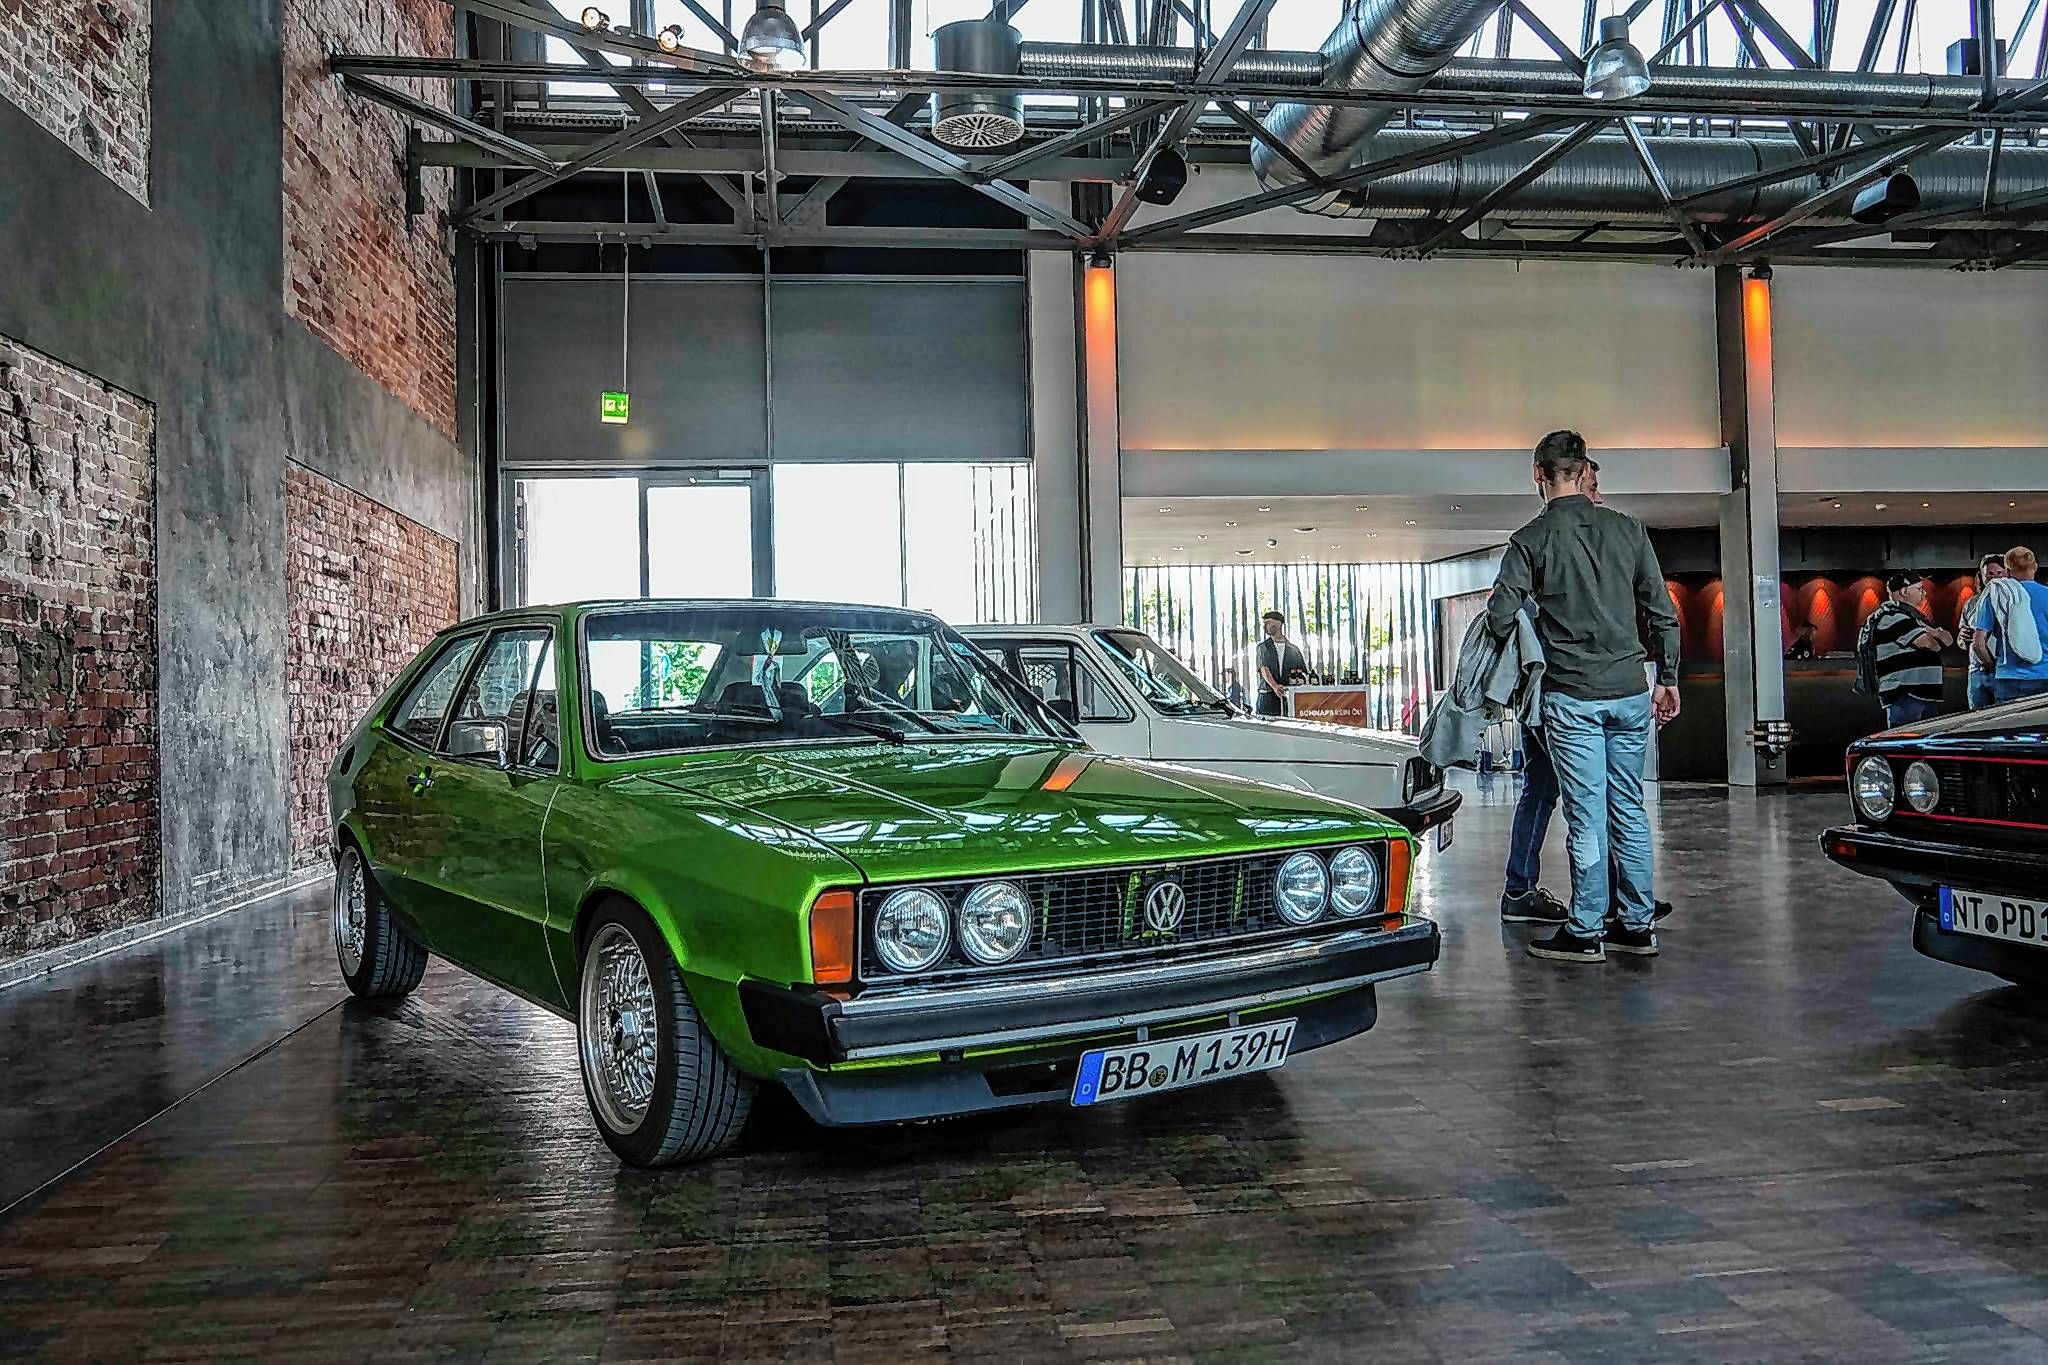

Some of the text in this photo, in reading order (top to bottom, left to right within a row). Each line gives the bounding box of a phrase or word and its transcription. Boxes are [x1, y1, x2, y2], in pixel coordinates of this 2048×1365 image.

[1147, 882, 1185, 931] VW
[1953, 895, 1983, 930] NT
[1099, 1051, 1151, 1095] BB
